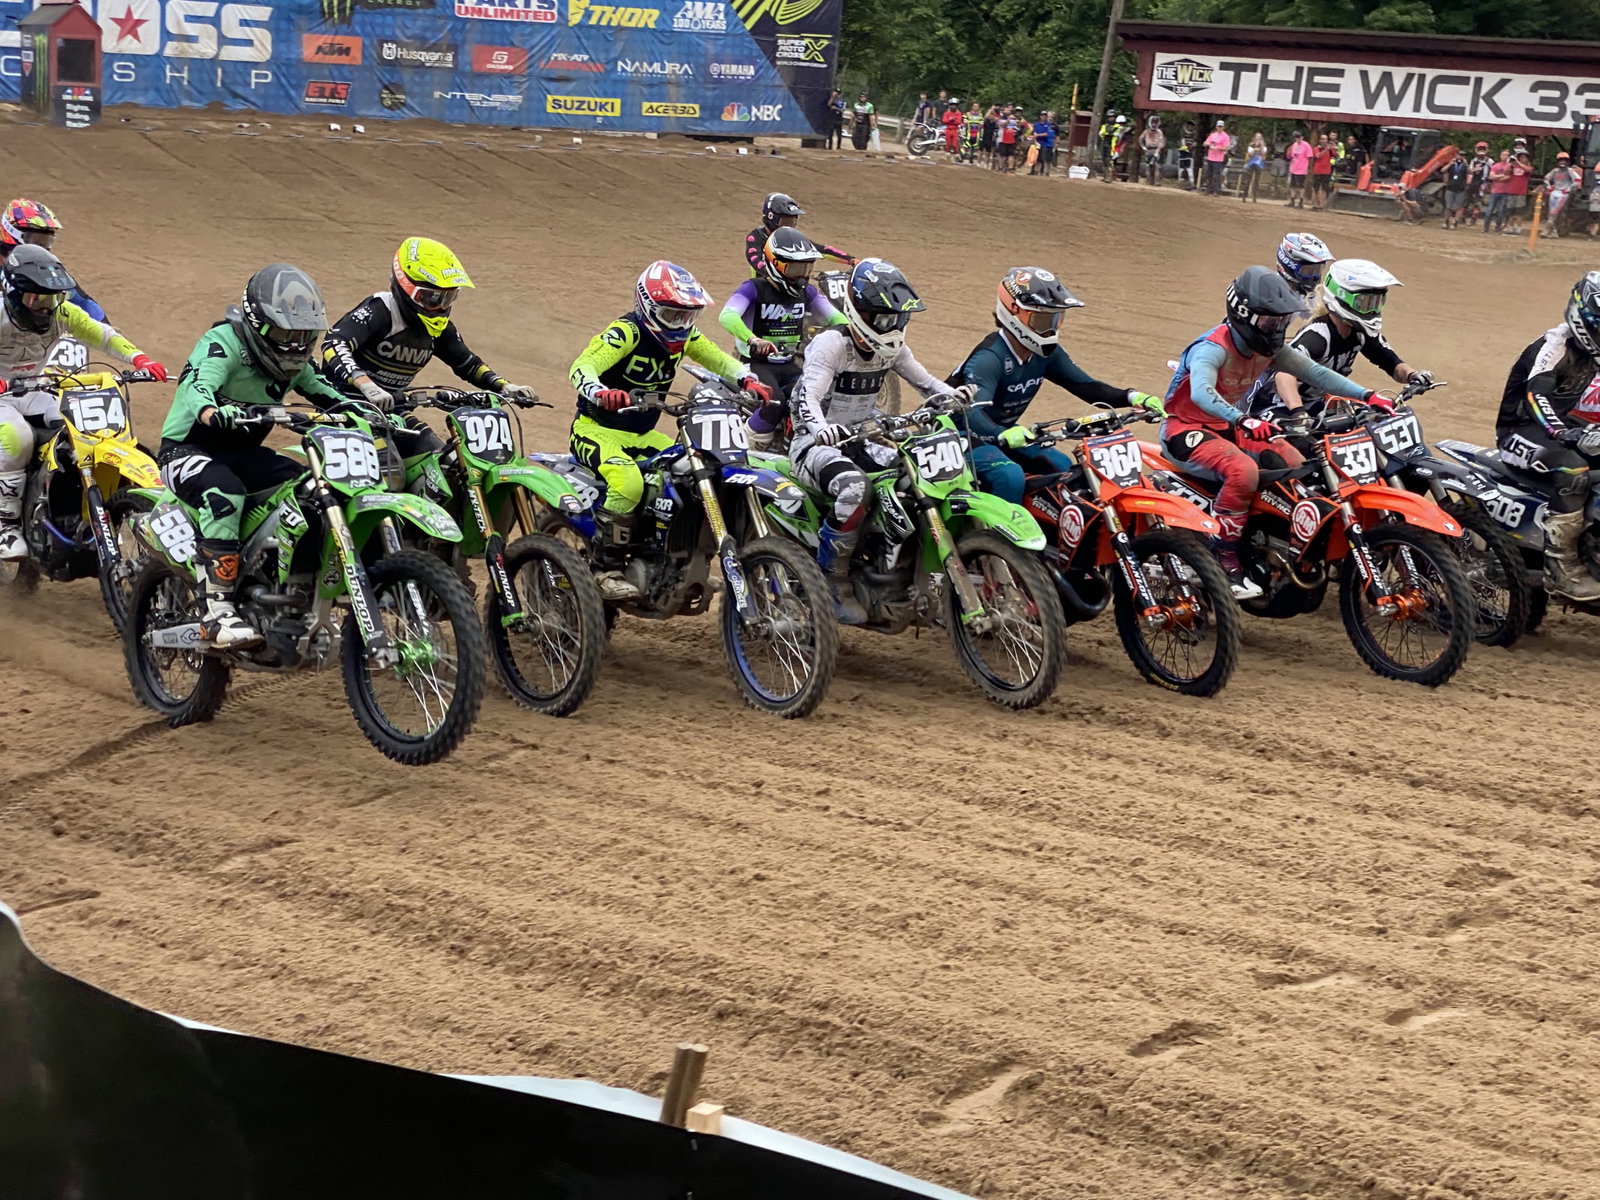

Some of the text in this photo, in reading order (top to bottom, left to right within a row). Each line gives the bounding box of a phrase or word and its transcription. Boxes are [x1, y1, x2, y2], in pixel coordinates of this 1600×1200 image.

[457, 5, 555, 21] UNLIMITED
[590, 5, 660, 29] THOR
[674, 1, 726, 19] AMA
[701, 19, 727, 30] YEARS
[315, 42, 352, 57] KTM
[397, 47, 454, 62] Husqvarna
[617, 58, 693, 75] NAMURA
[721, 63, 756, 76] YAMAHA
[1157, 67, 1176, 79] THE
[307, 81, 350, 99] ETS
[1218, 61, 1346, 107] THE
[1359, 69, 1513, 119] WICK
[551, 98, 615, 114] SUZUKI
[751, 104, 783, 122] NBC
[69, 397, 126, 433] 154
[465, 415, 513, 454] 924
[1379, 415, 1422, 455] 537
[323, 436, 381, 481] 588
[917, 440, 964, 480] 540
[1091, 441, 1142, 480] 364
[1336, 440, 1378, 479] 337
[1361, 546, 1384, 591] DUNLOP
[345, 563, 375, 632] DUNLOP
